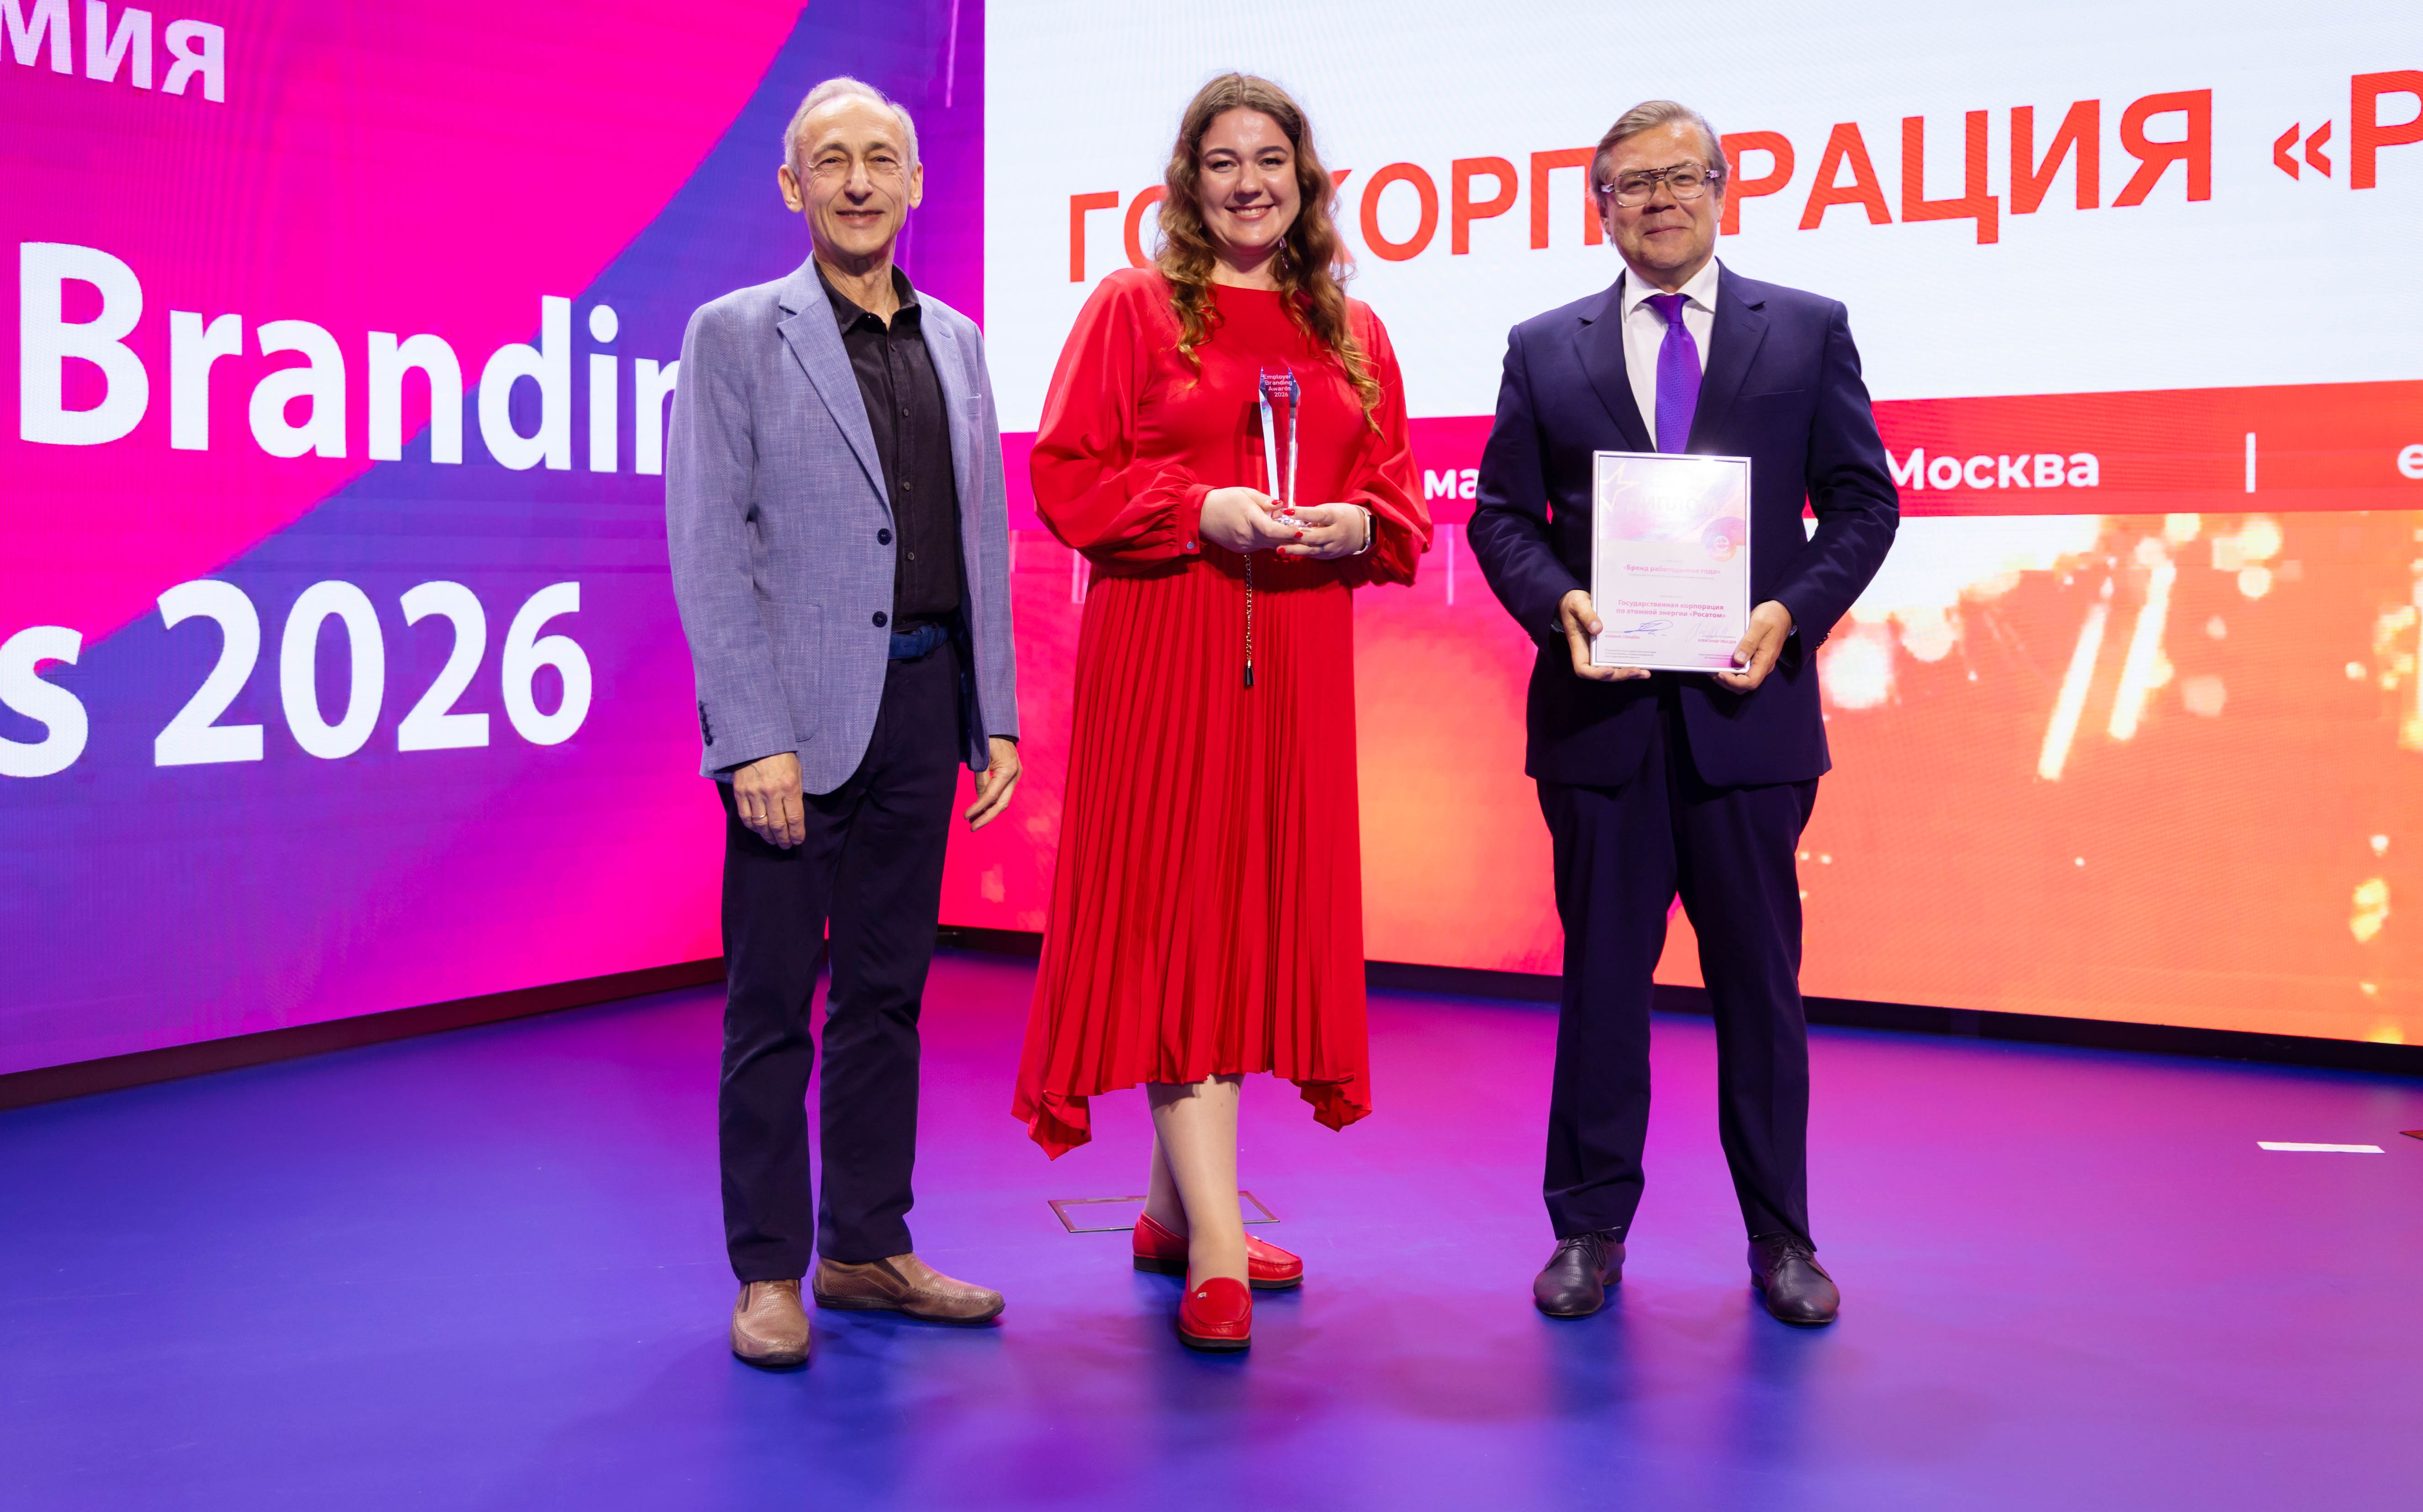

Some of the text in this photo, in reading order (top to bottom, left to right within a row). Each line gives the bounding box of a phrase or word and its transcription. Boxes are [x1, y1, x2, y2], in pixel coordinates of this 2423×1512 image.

[1424, 469, 1479, 500] ма
[1619, 600, 1678, 608] Государственная
[154, 579, 592, 766] 2026
